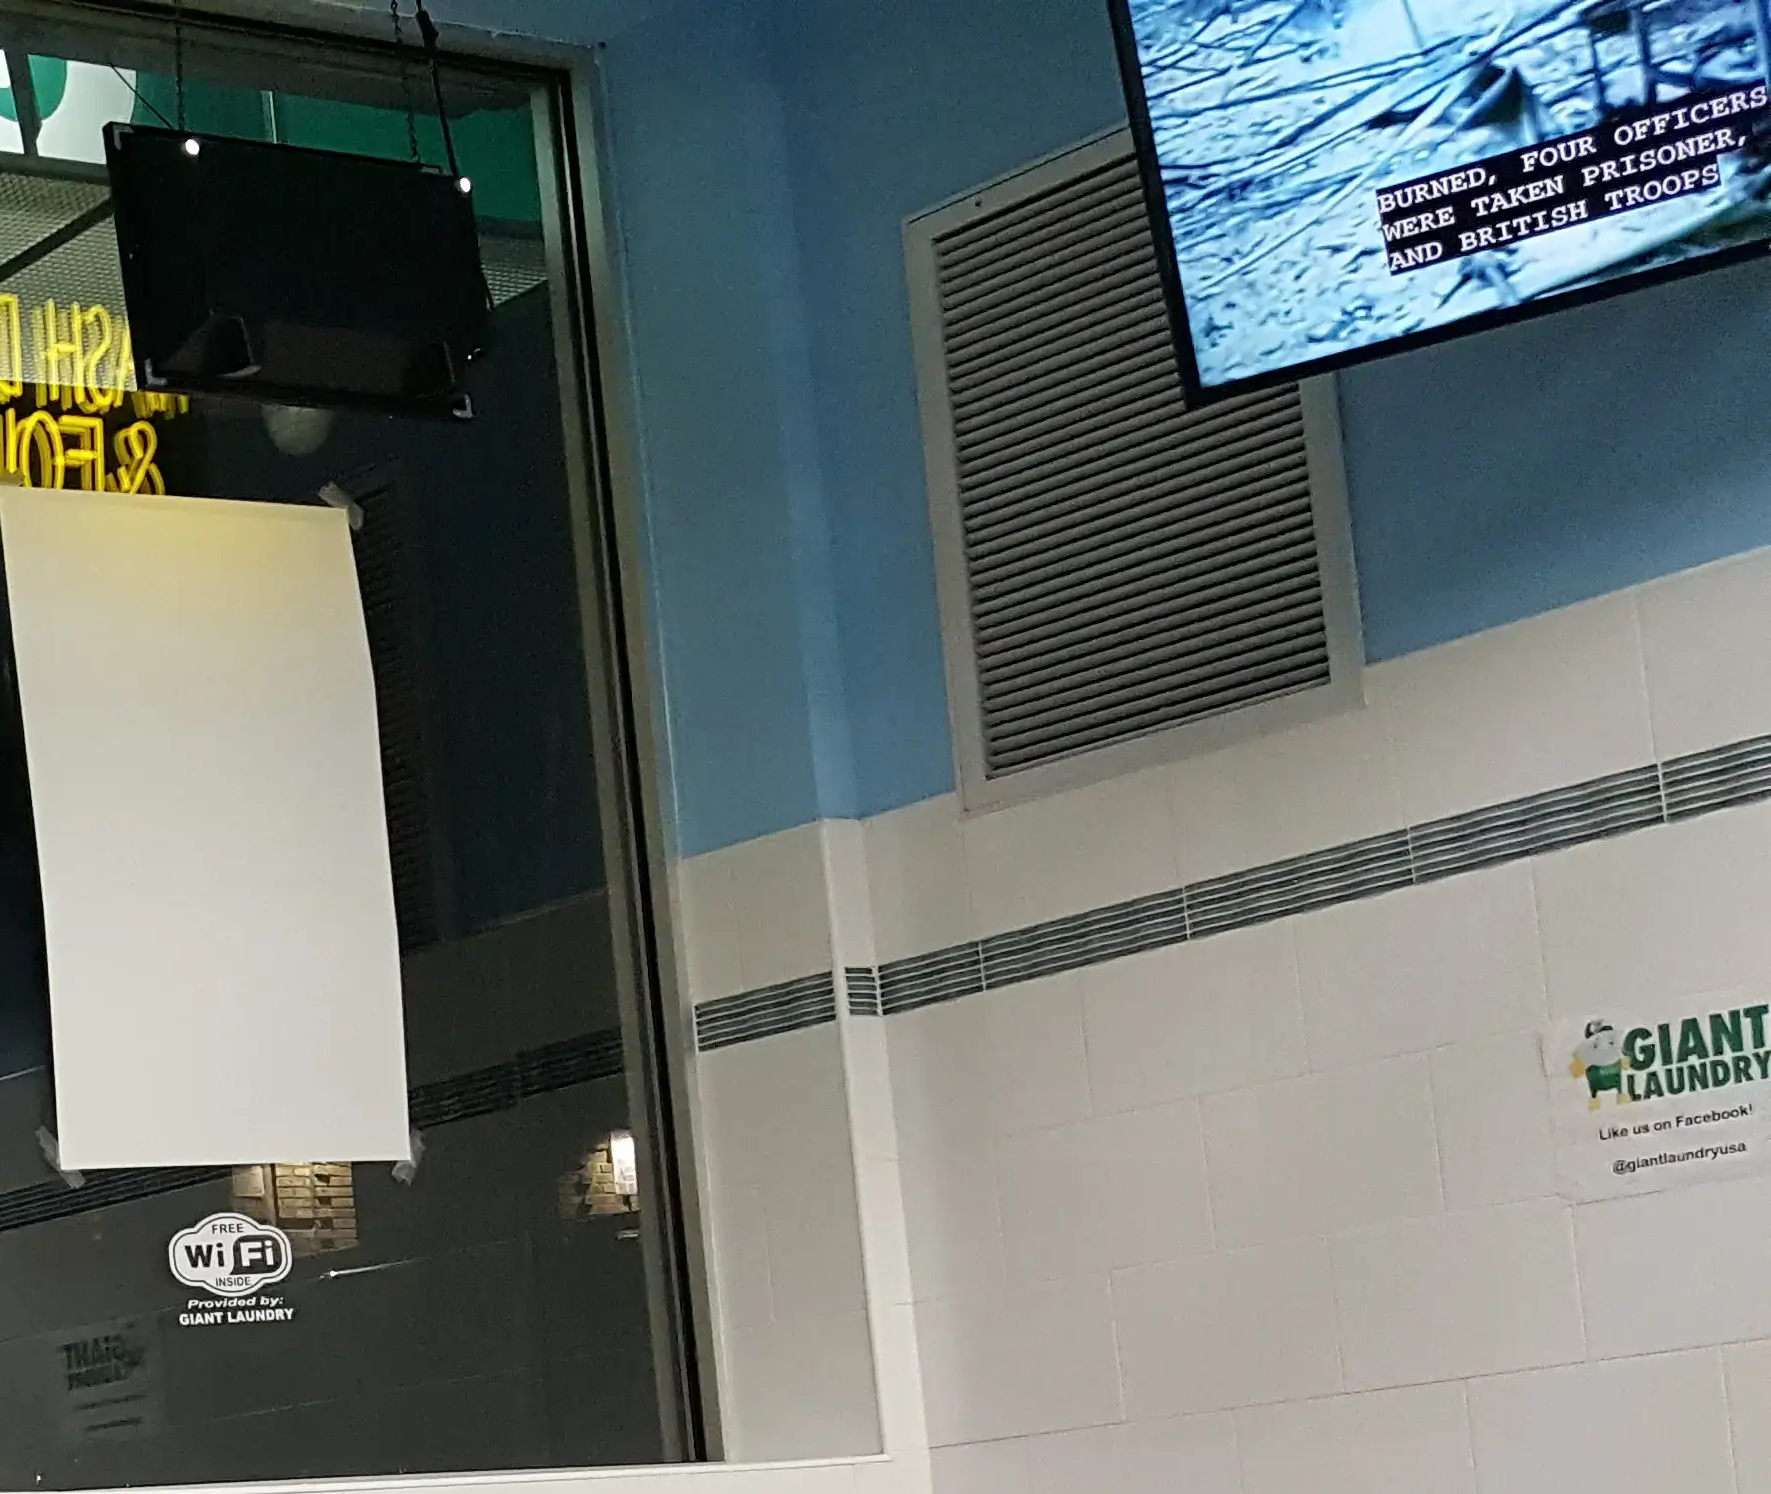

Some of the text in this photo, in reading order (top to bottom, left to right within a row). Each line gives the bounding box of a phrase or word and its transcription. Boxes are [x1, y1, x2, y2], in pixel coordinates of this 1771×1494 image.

[1377, 85, 1769, 213] BURNED, FOUR OFFICERS
[1383, 127, 1747, 242] WERE TAKEN PRISONER,
[1389, 164, 1720, 272] AND BRITISH TROOPS
[1622, 1004, 1769, 1071] GIANT
[1627, 1050, 1771, 1101] LAUNDRY
[1599, 1103, 1754, 1140] Like us on Facebook!
[1613, 1141, 1747, 1175] @giantlaundryusa
[212, 1223, 244, 1234] FREE
[216, 1276, 251, 1287] INSIDE
[179, 1308, 294, 1325] GIANT LAUNDRY
[188, 1295, 283, 1309] Provided by:
